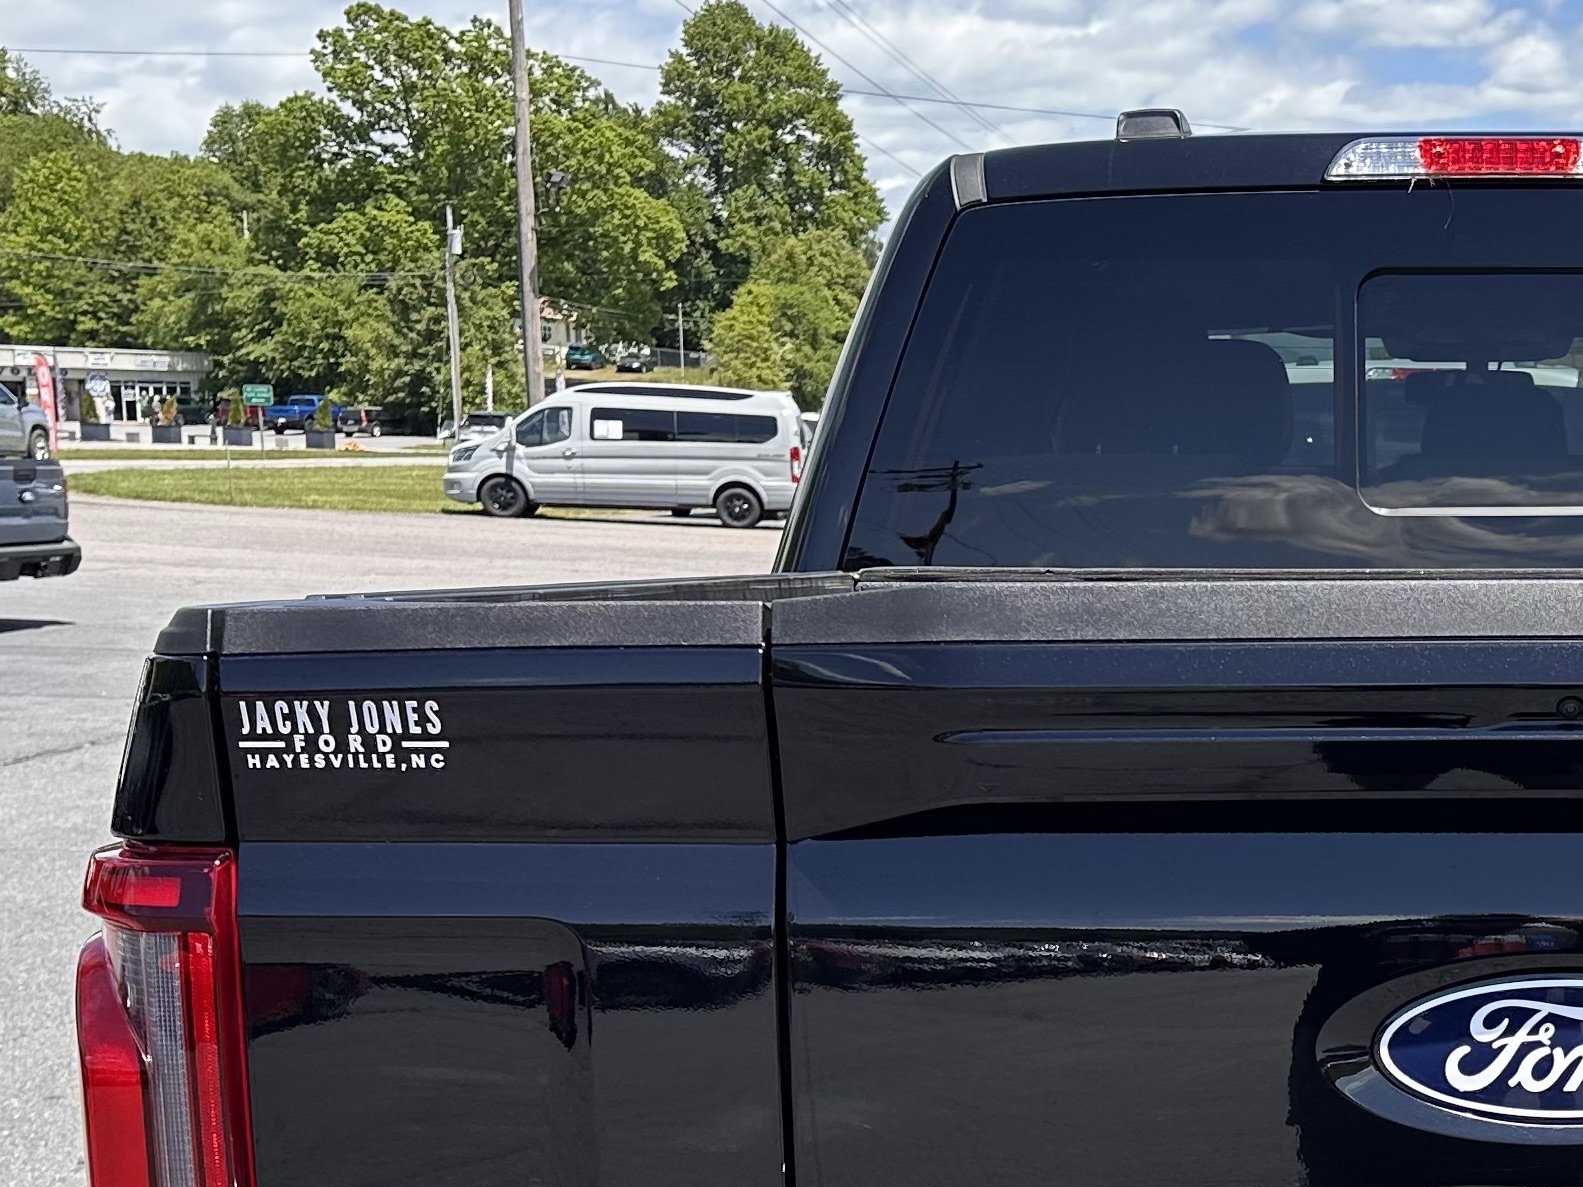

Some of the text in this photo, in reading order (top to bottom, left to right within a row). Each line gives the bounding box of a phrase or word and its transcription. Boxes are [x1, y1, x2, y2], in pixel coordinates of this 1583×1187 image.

[238, 700, 442, 735] JACKY JONES
[293, 734, 393, 752] FORD
